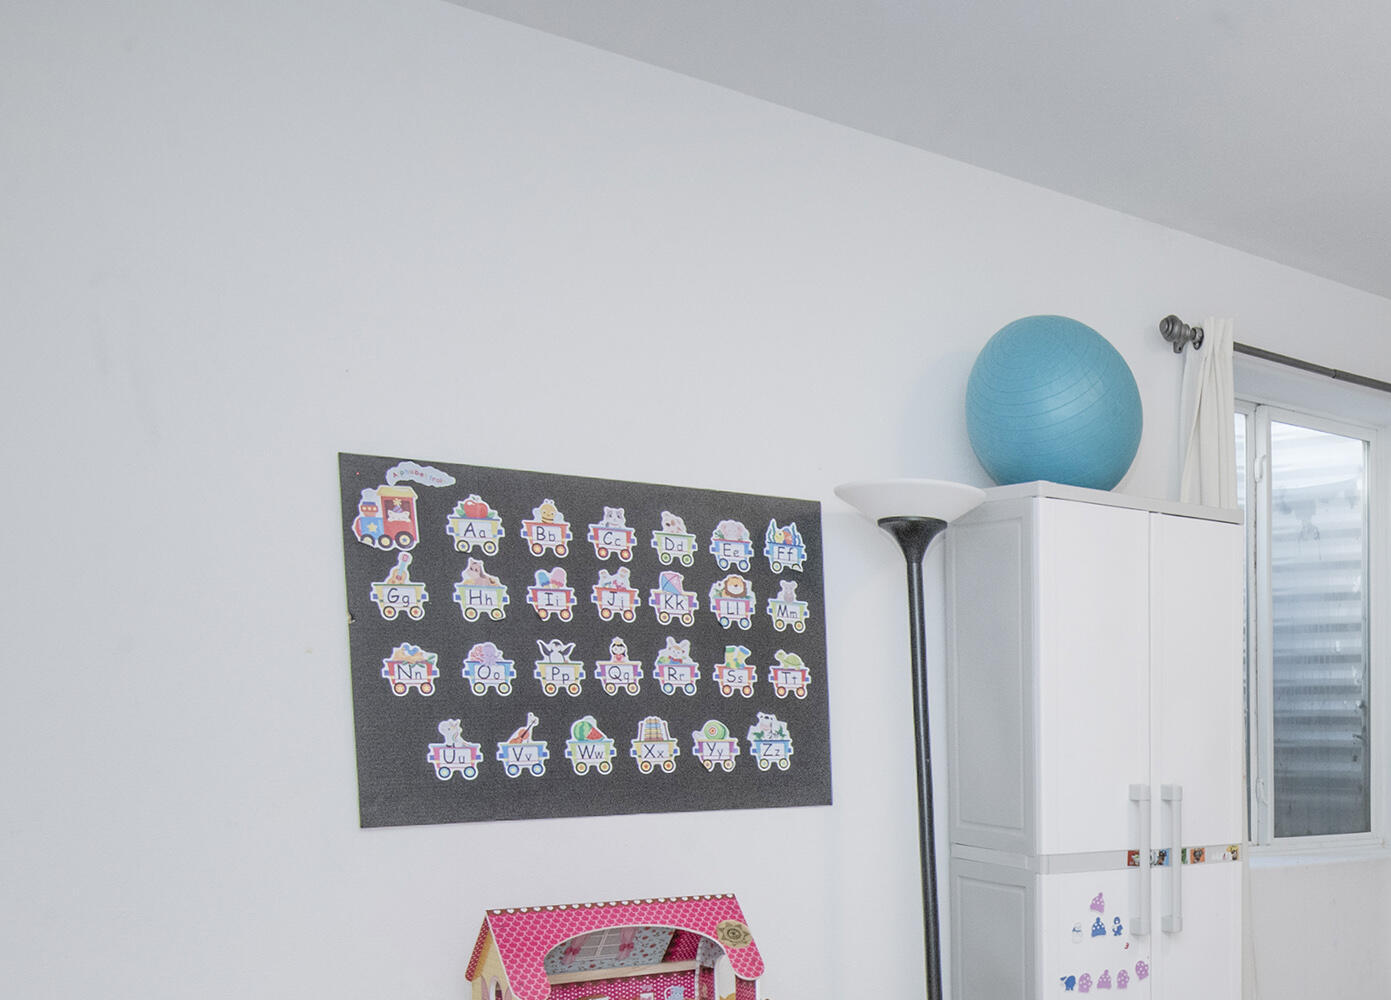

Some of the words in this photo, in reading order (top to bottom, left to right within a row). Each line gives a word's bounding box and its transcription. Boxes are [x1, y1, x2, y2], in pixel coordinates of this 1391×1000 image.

[464, 523, 486, 539] Aa
[536, 526, 556, 541] Bb
[603, 532, 621, 546] Cc
[665, 537, 683, 551] Dd
[723, 543, 740, 557] Ee
[777, 546, 793, 561] Ff
[387, 588, 410, 606] Gg
[469, 589, 493, 606] Hh
[545, 591, 559, 606] Ii
[608, 592, 624, 609] Jj
[664, 594, 685, 610] Kk
[727, 601, 740, 615] Ll
[777, 605, 798, 619] Mm
[398, 665, 422, 680] Nn
[478, 664, 500, 680] Oo
[552, 667, 570, 684] Pp
[608, 666, 630, 682] Qq
[668, 667, 685, 681] Rr
[727, 670, 743, 684] Ss
[781, 672, 798, 685] Tt
[443, 748, 465, 764] Uu
[512, 748, 532, 762] Vv
[578, 745, 604, 760] Ww
[643, 744, 664, 759] Xx
[707, 743, 724, 759] Yy
[763, 744, 780, 757] Zz
